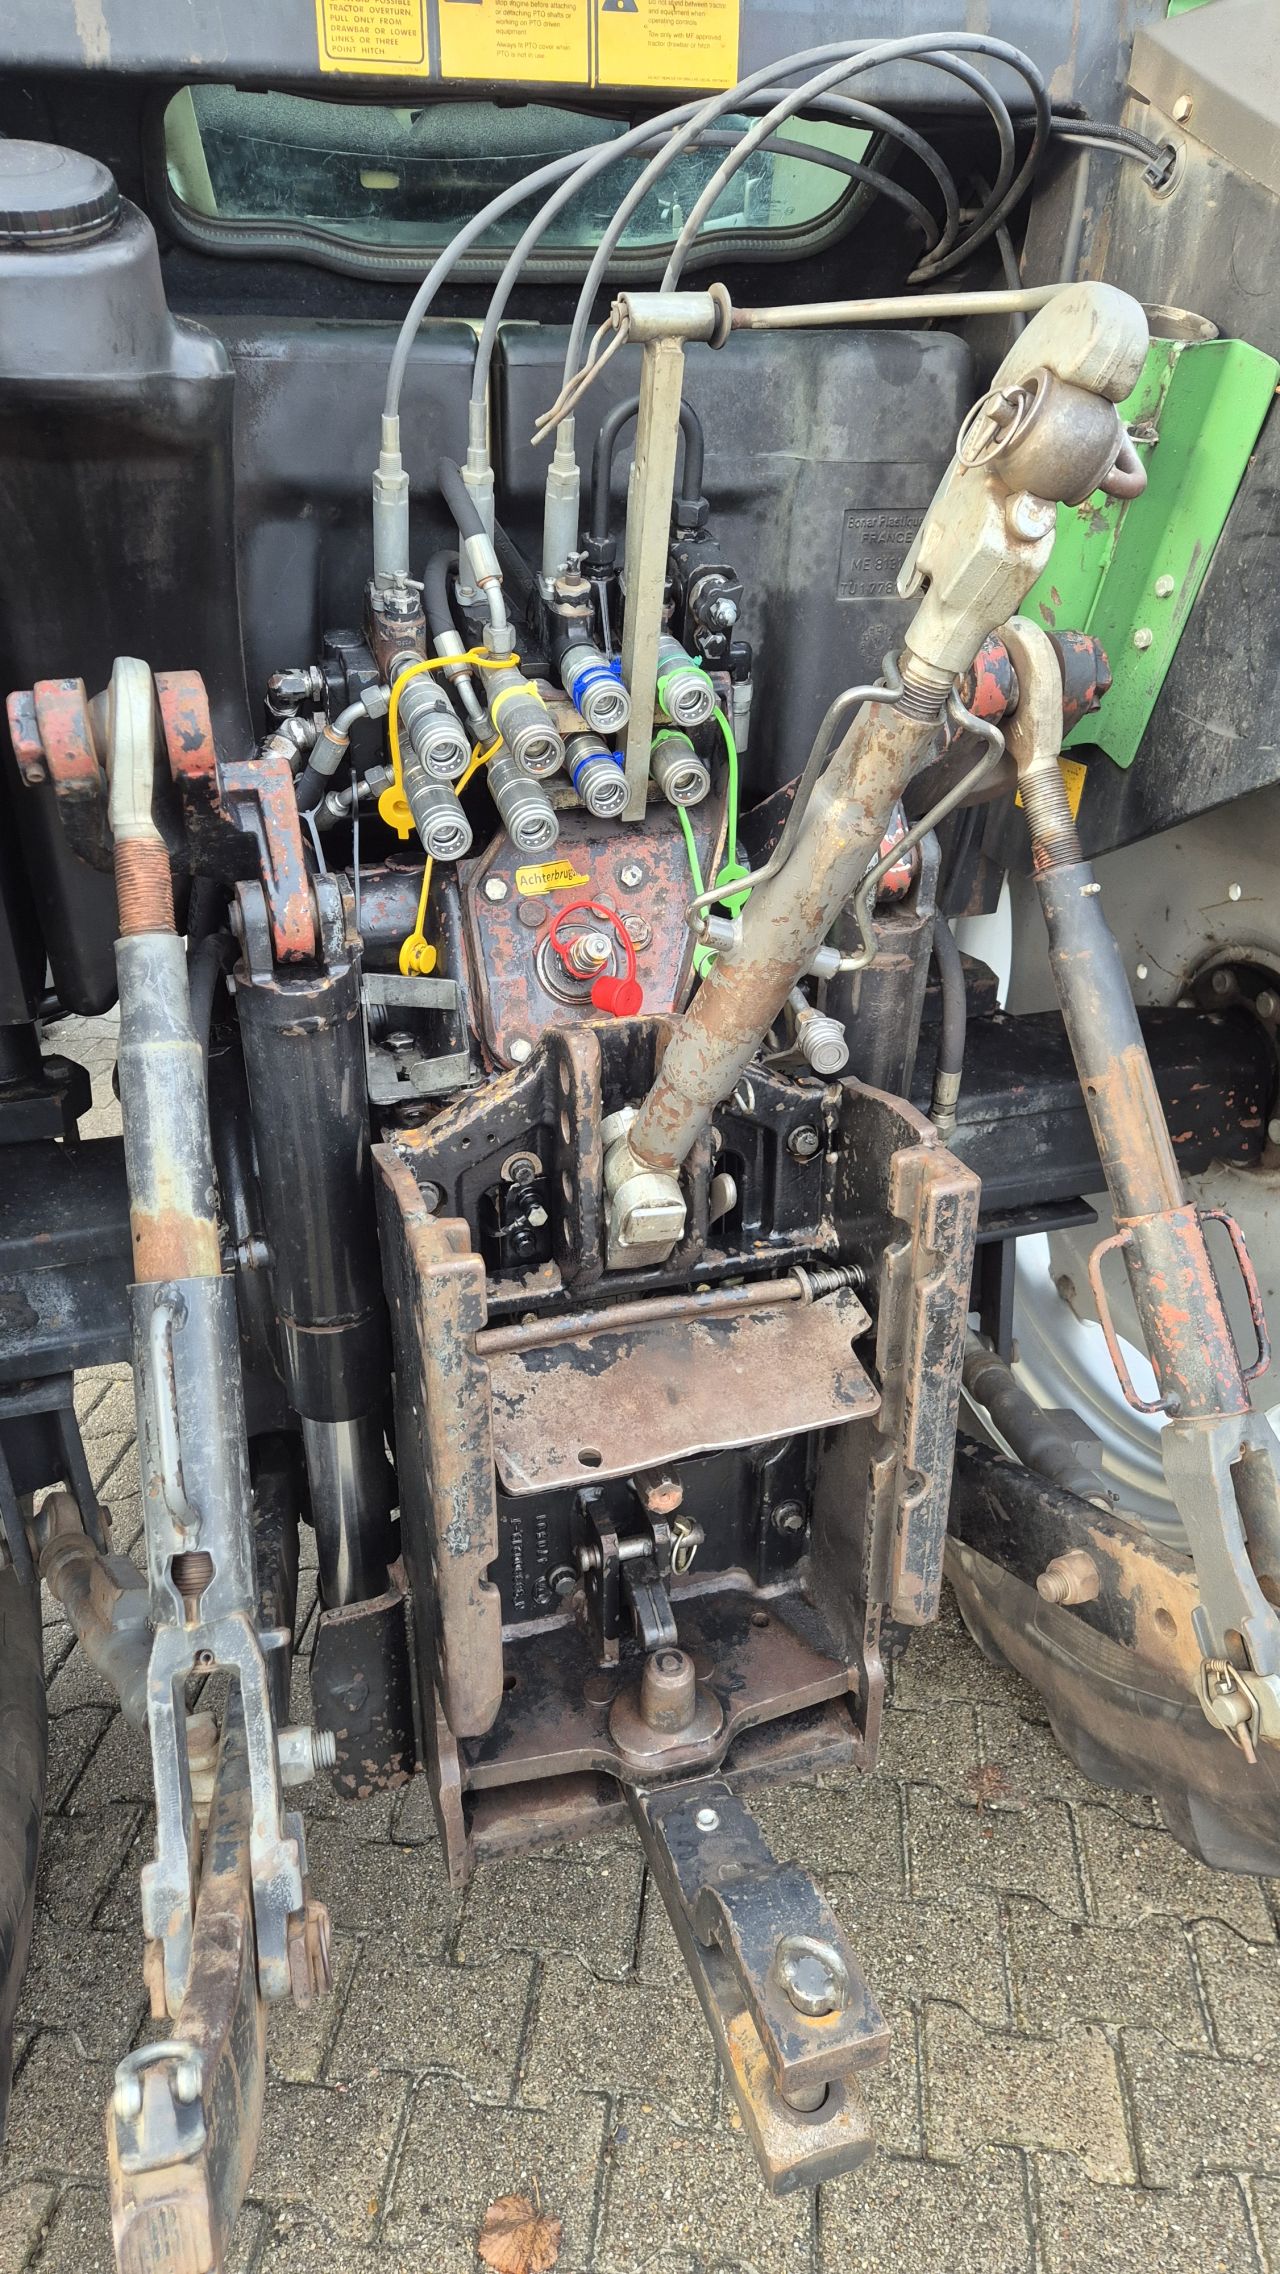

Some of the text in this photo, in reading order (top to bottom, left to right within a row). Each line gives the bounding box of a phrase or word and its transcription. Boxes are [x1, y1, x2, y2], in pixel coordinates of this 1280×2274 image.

[329, 4, 364, 12] TRACTOR
[550, 2, 577, 11] attaching
[503, 10, 531, 18] detaching
[660, 9, 690, 18] equipment
[354, 16, 374, 24] ONLY
[648, 18, 675, 26] operating
[331, 25, 369, 33] DRAWBAR
[497, 41, 517, 49] Always
[362, 47, 385, 55] HITCH
[848, 517, 877, 529] Bonar
[862, 532, 913, 544] FRANCE
[851, 558, 871, 571] ME
